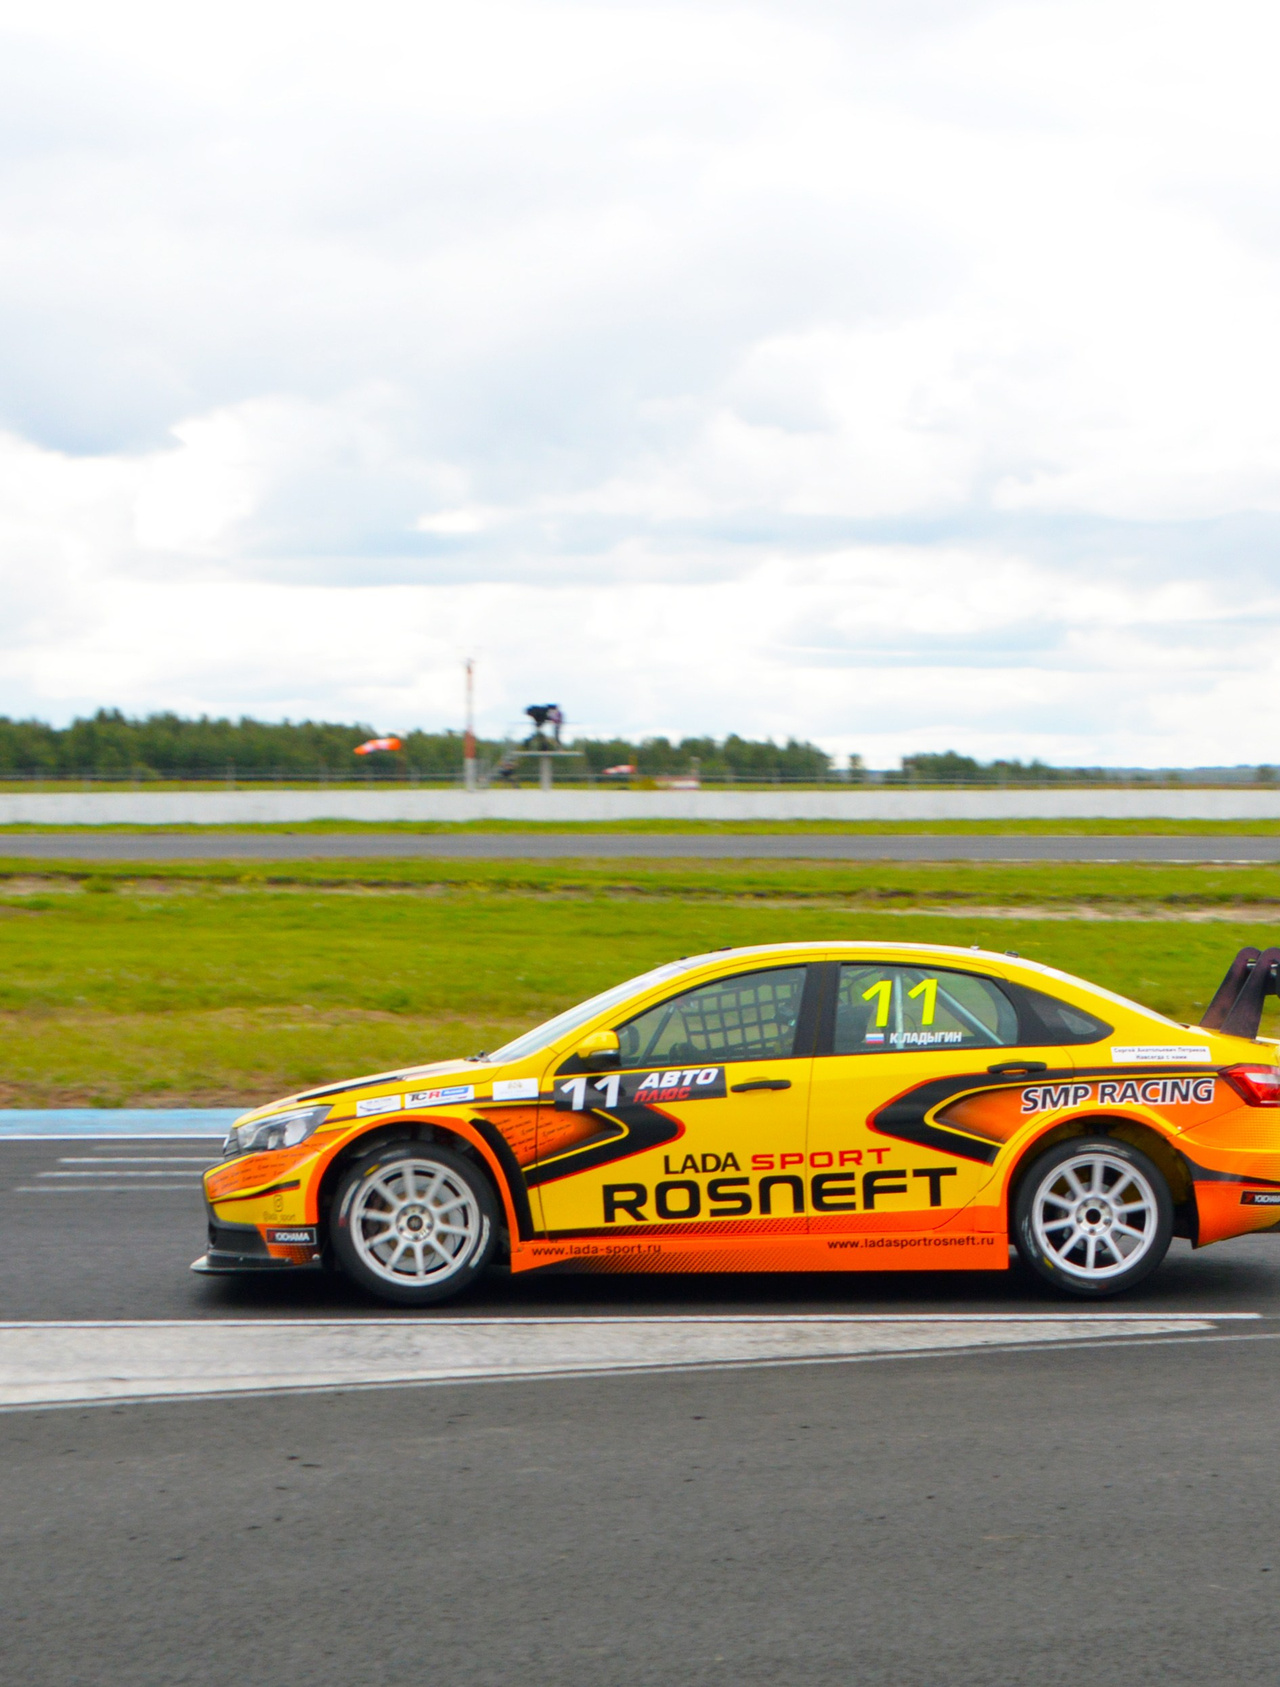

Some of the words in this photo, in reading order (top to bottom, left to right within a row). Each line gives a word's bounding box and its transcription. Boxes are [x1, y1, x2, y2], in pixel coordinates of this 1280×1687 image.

[861, 978, 938, 1028] 11
[560, 1074, 621, 1111] 11
[637, 1067, 719, 1090] АВТО
[632, 1086, 692, 1103] ПЛЮС
[1020, 1083, 1092, 1114] SMP
[1098, 1078, 1215, 1106] RACING
[663, 1152, 741, 1175] LADA
[751, 1147, 892, 1171] SPORT
[601, 1166, 958, 1224] ROSNEFT
[531, 1244, 662, 1256] www.lada-sport.ru
[827, 1235, 995, 1249] www.ladasportrosneft.ru
